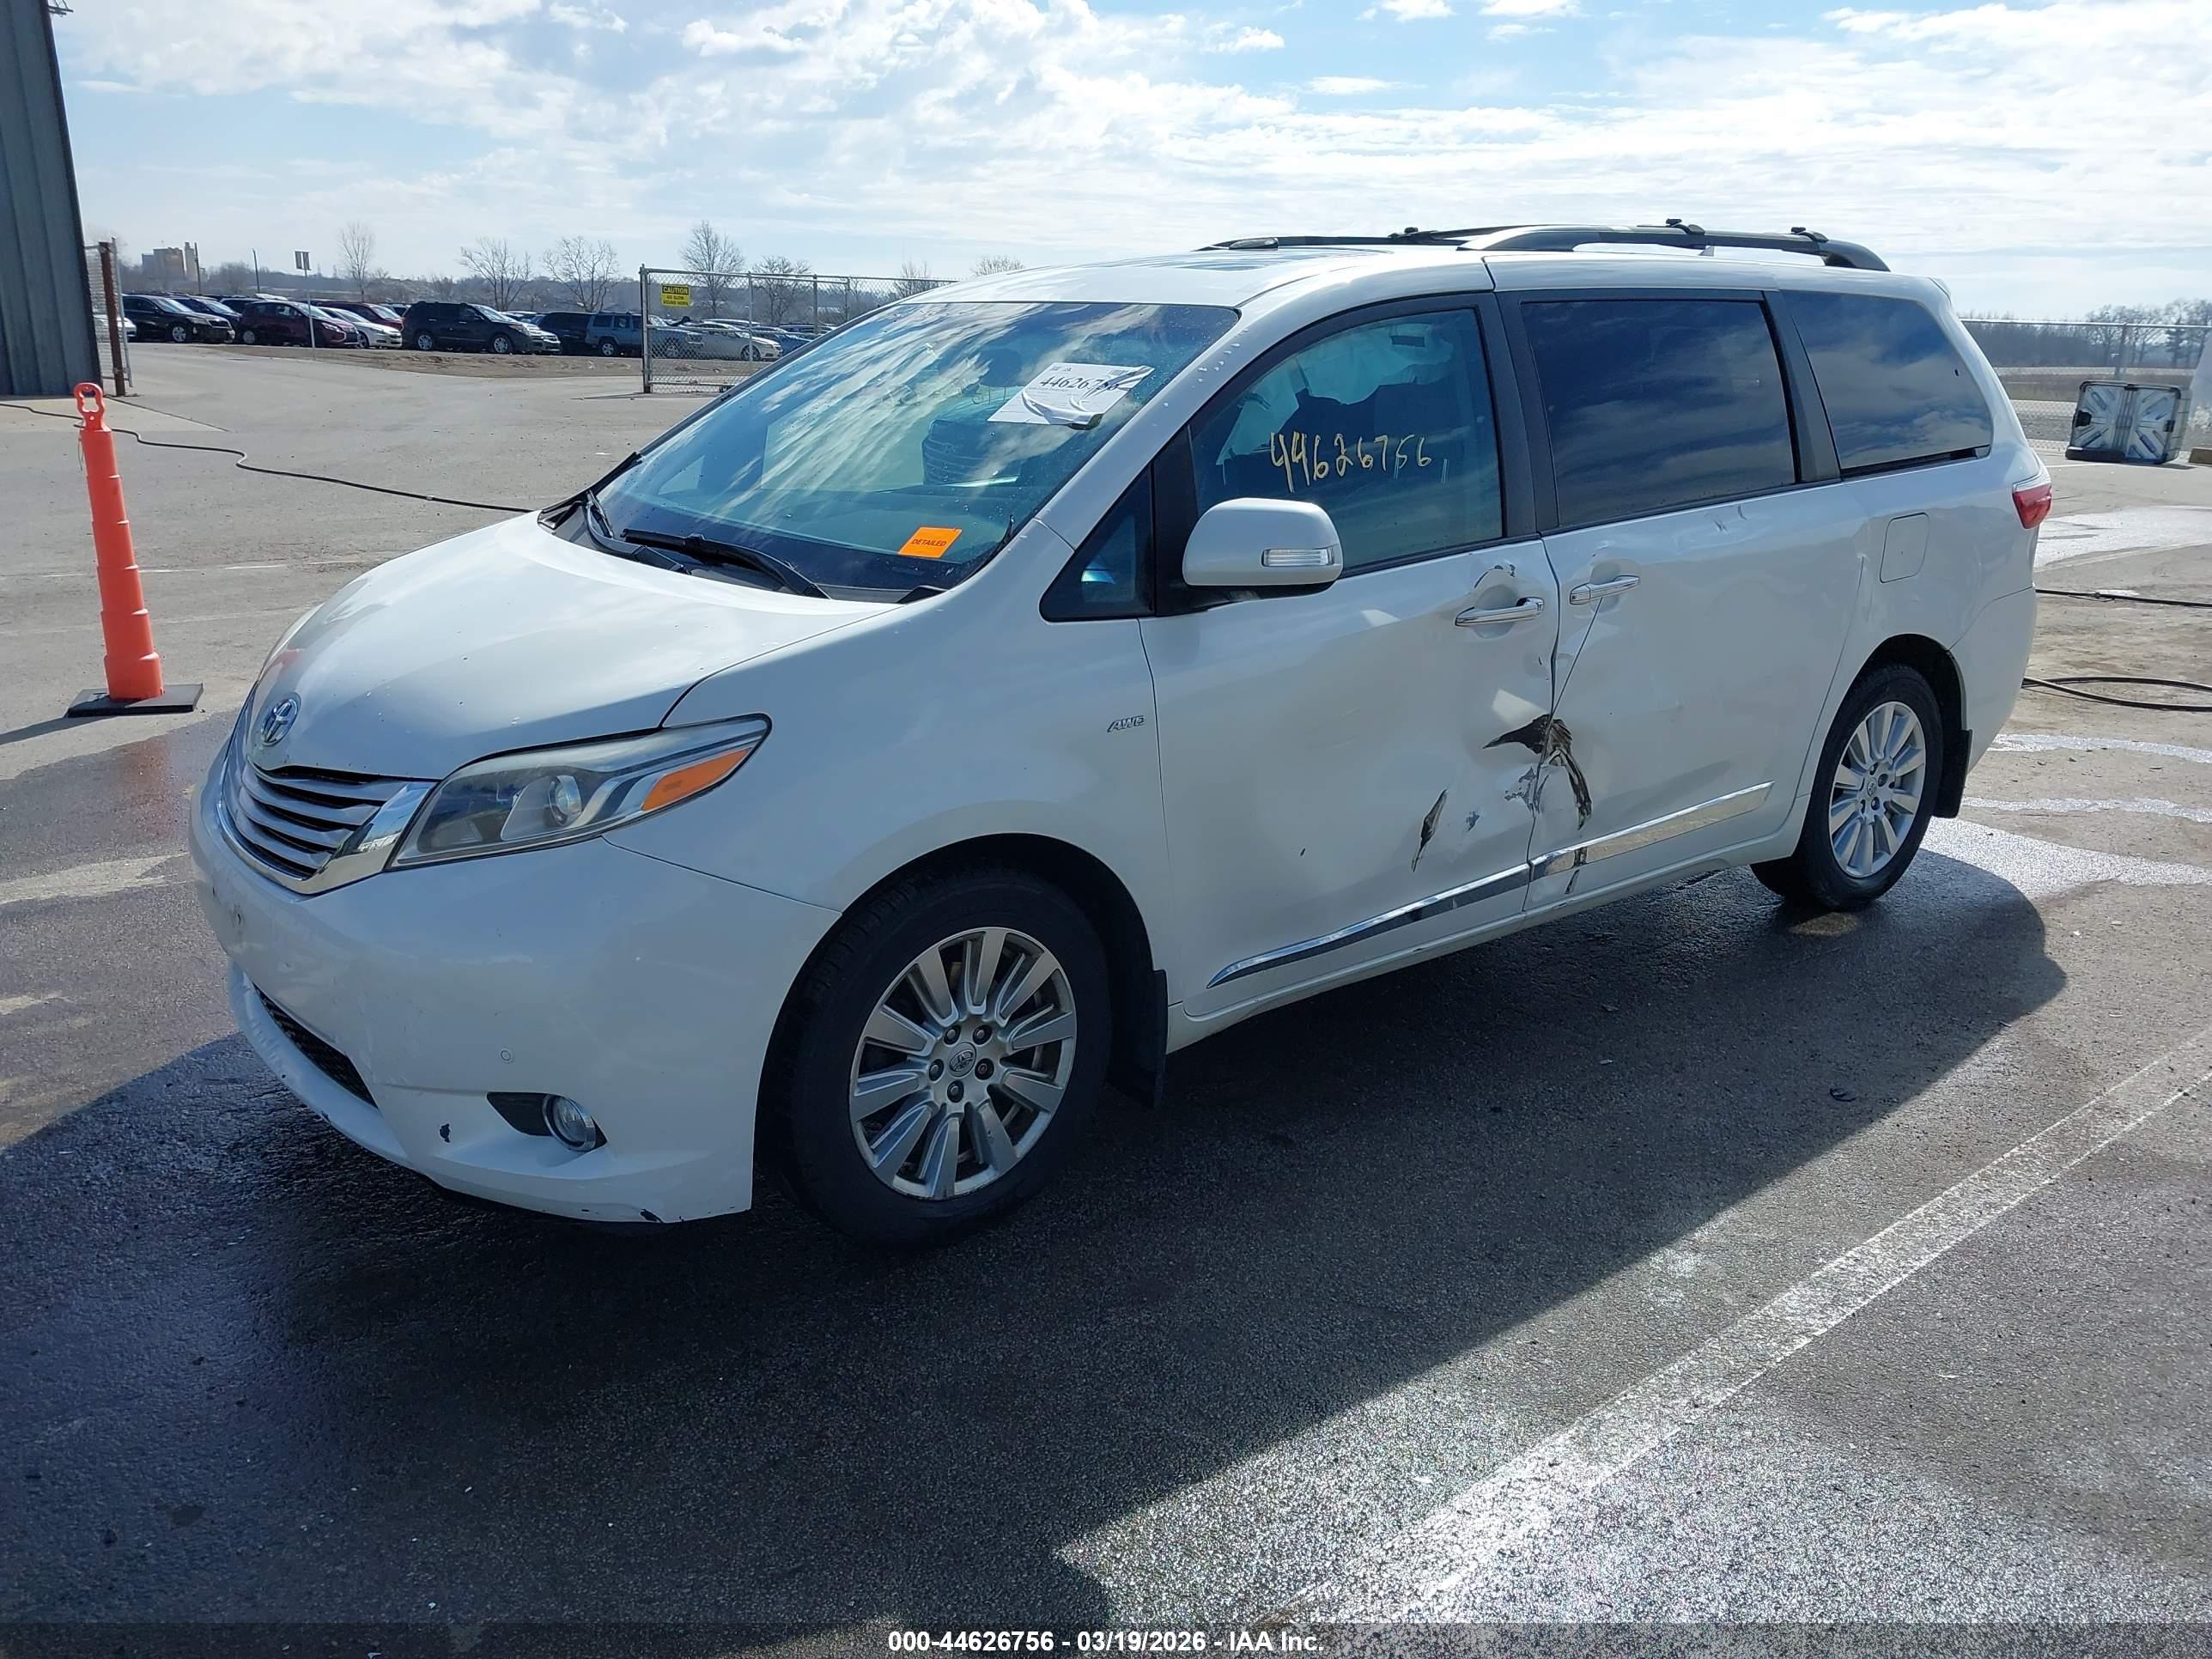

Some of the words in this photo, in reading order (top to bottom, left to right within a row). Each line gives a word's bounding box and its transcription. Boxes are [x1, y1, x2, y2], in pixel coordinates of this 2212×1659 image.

[663, 286, 688, 295] CAUTION
[1270, 430, 1433, 494] 44626756
[911, 538, 947, 547] DETAILED
[1107, 714, 1145, 733] AWD
